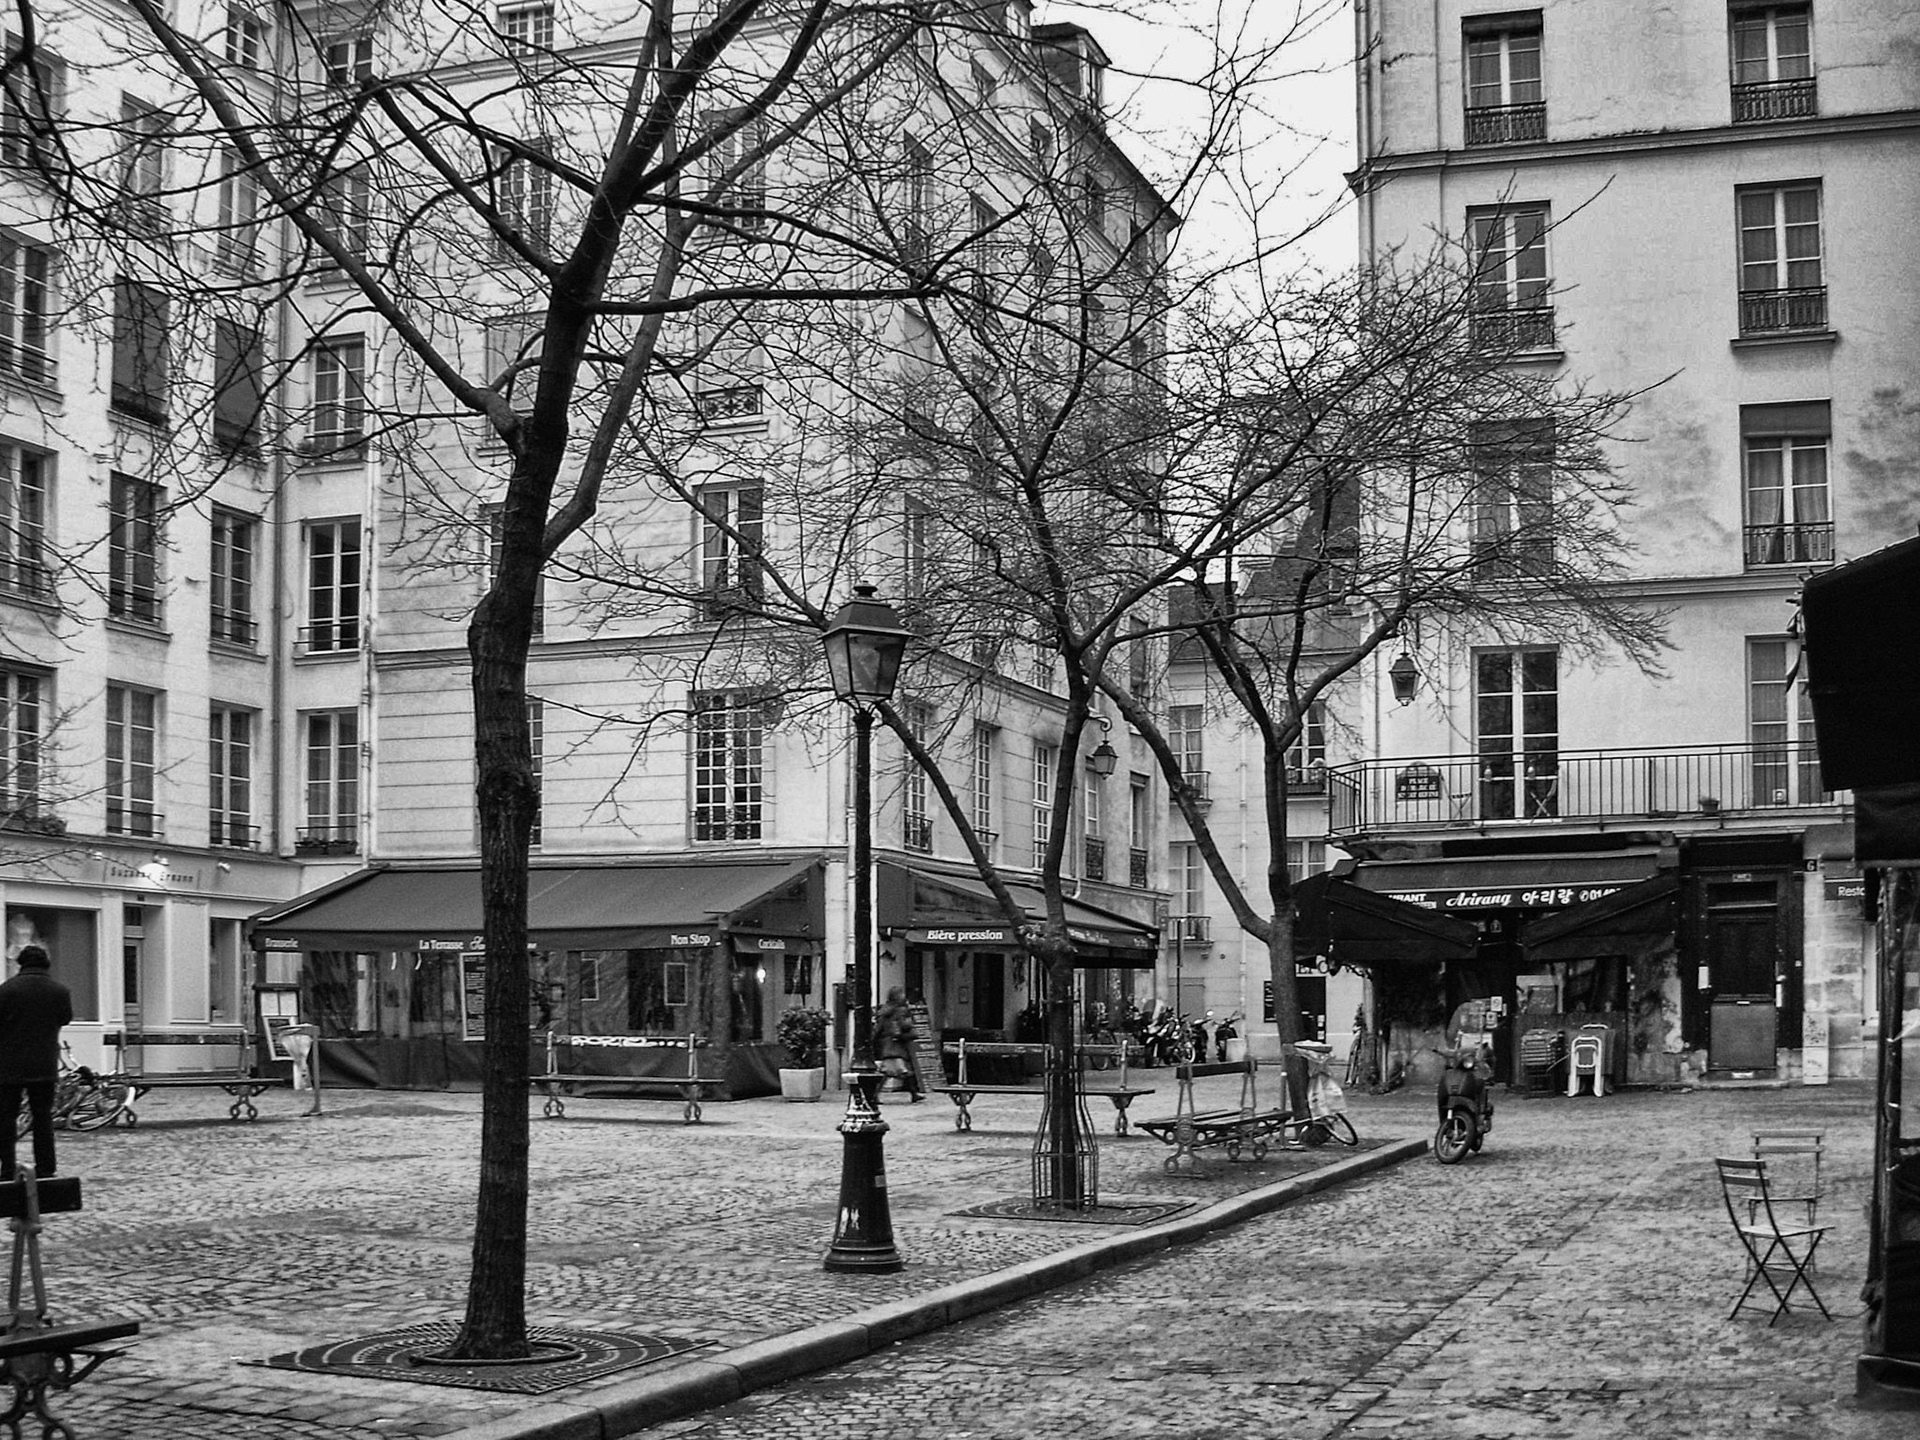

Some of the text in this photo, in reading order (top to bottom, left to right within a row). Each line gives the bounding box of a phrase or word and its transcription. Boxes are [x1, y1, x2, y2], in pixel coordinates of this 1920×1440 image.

[1445, 892, 1512, 907] Arirang
[1521, 888, 1574, 905] 아리랑
[689, 934, 711, 946] Stop
[927, 930, 1003, 942] Bière pression
[419, 940, 430, 950] La
